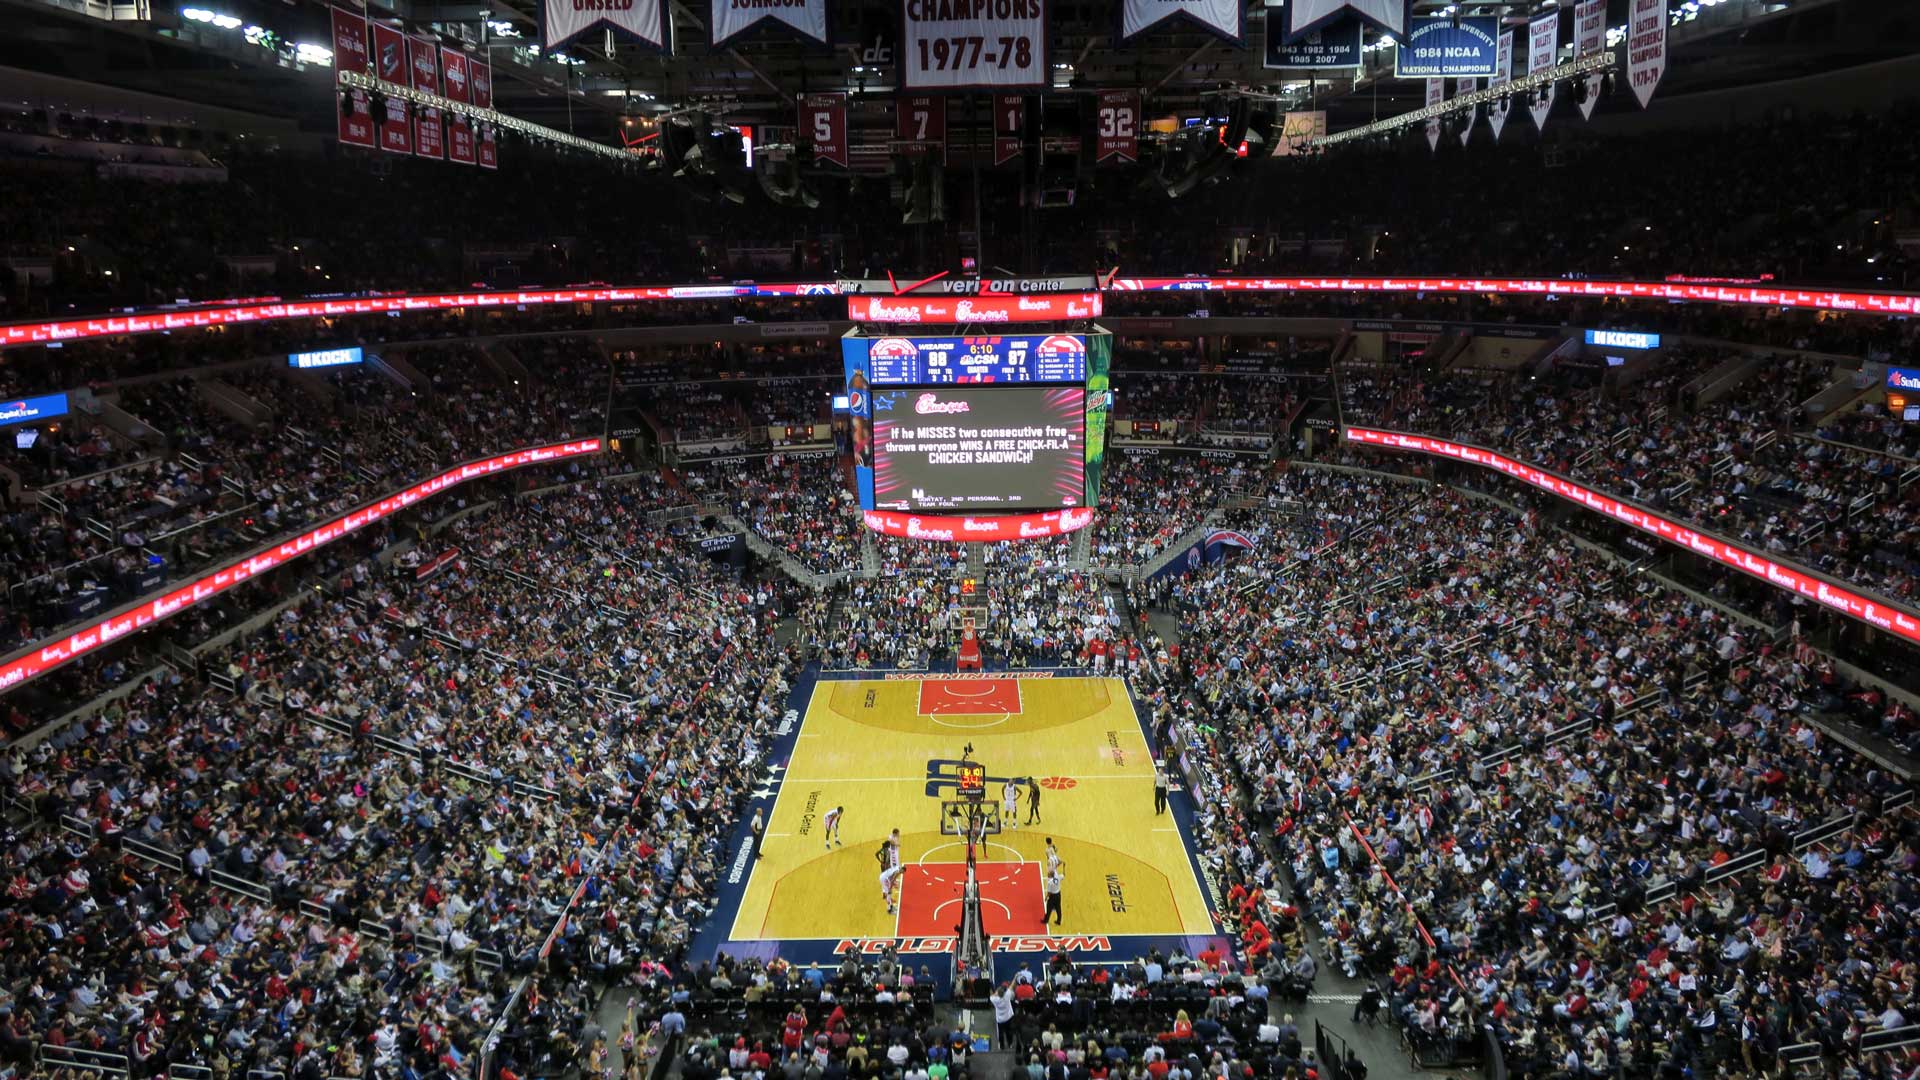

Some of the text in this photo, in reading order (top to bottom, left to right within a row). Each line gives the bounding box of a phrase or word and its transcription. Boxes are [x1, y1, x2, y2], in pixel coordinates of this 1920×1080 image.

[906, 0, 1041, 22] CHAMPIONS
[918, 36, 1033, 71] 1977-78
[1445, 47, 1481, 57] NCAA
[1316, 56, 1337, 64] 2007
[1402, 64, 1491, 73] NATIONAL CHAMPIONS
[814, 112, 831, 142] 5
[914, 111, 929, 140] 7
[1100, 108, 1133, 138] 32
[942, 276, 1065, 297] verizon Center
[1606, 331, 1647, 348] KOCH
[970, 345, 993, 354] 6:10
[312, 350, 352, 366] KOCH
[974, 354, 999, 365] CSN
[1008, 350, 1026, 365] 87
[1306, 418, 1335, 426] ETIHAD
[612, 428, 641, 436] ETIHAD
[891, 427, 899, 439] If
[901, 427, 914, 439] he
[917, 427, 956, 439] MISSES
[958, 428, 978, 438] two
[980, 426, 1044, 438] consecutive
[1046, 425, 1067, 438] free
[885, 438, 1069, 453] throws everyone WINS A FREE CHICK-FIL-A
[711, 457, 746, 466] ETIHAD
[929, 449, 1033, 464] CHICKEN SANDWICH!
[1200, 451, 1236, 459] ETIHAD
[701, 535, 736, 549] ETIHAD
[961, 775, 979, 789] 24
